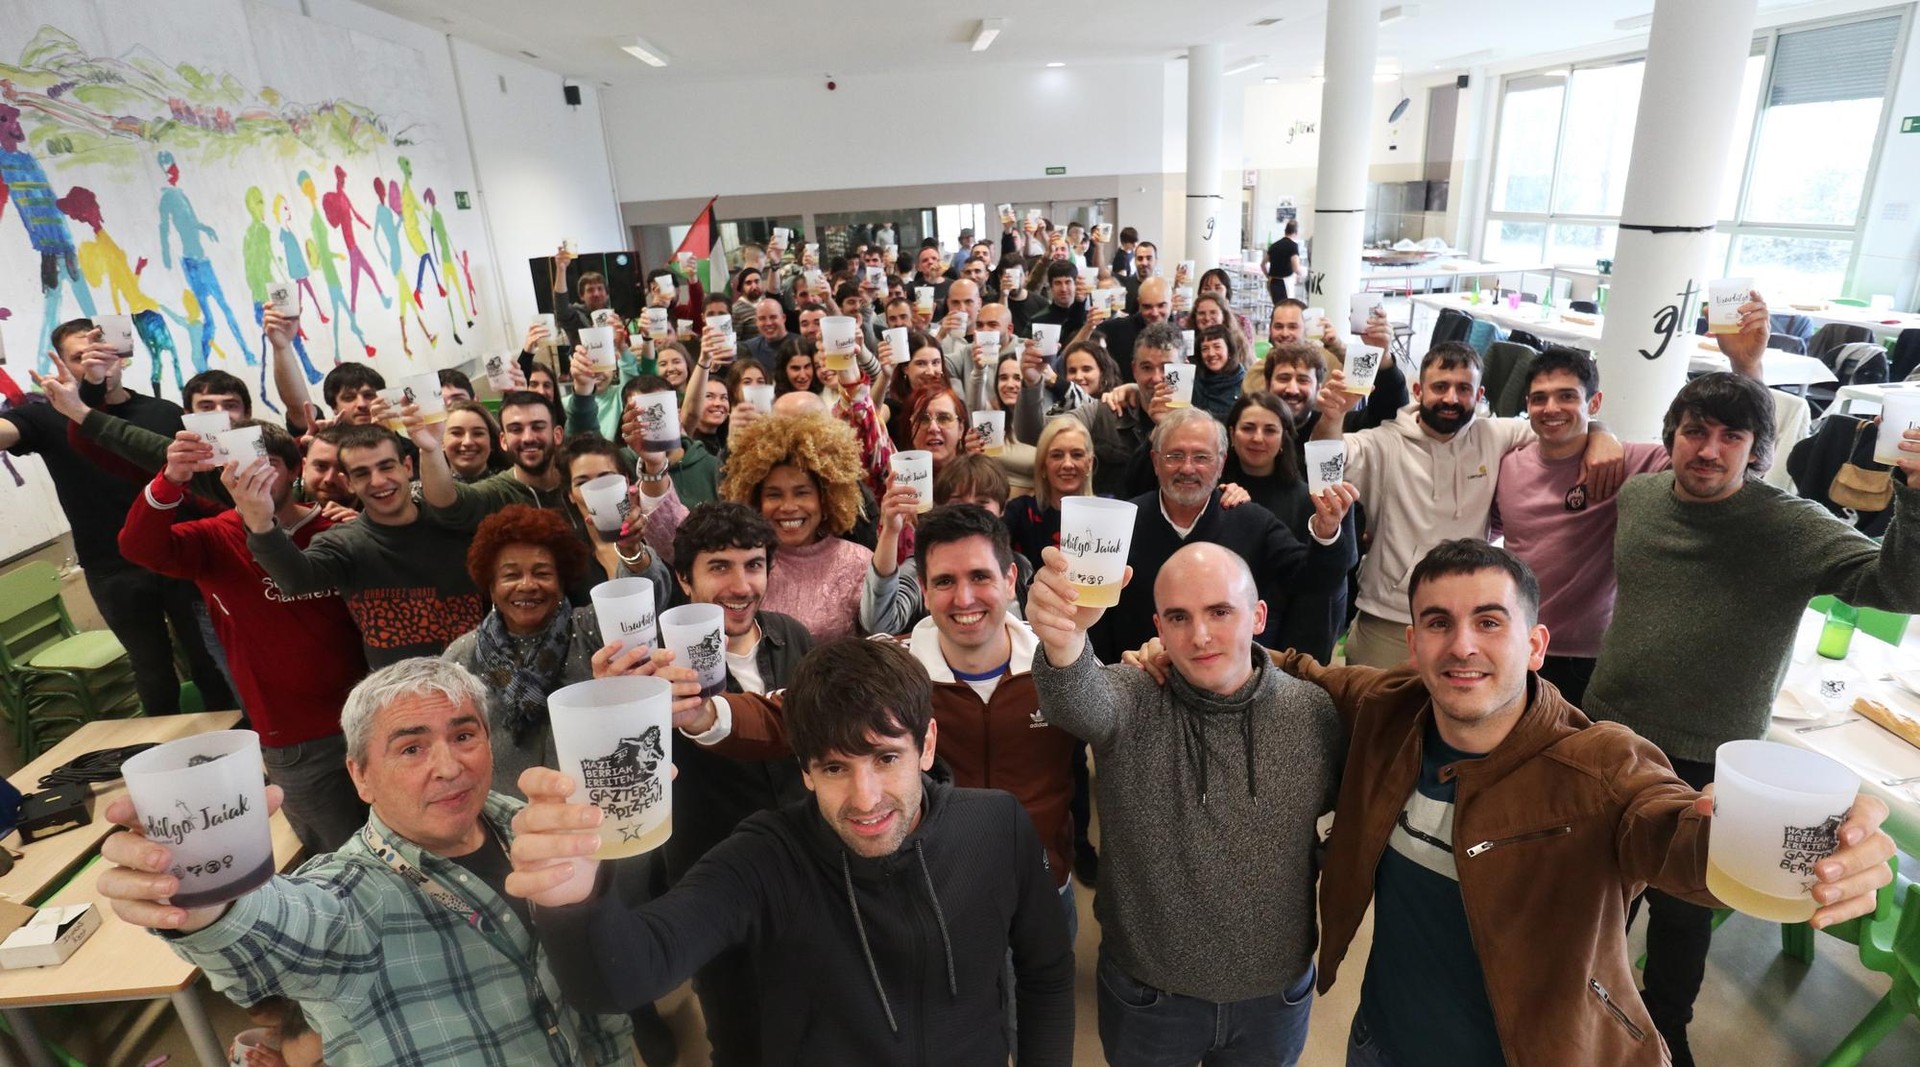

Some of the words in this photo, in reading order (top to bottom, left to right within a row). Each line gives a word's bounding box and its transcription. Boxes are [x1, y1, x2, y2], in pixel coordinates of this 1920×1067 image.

[1094, 538, 1121, 553] Jaiak
[584, 760, 612, 770] HAZI
[585, 765, 633, 778] BERRIAK
[589, 777, 659, 803] GAZTERIA
[590, 784, 663, 820] RPIZTEN!
[200, 794, 250, 830] Jaiak
[1787, 828, 1815, 837] HAZI
